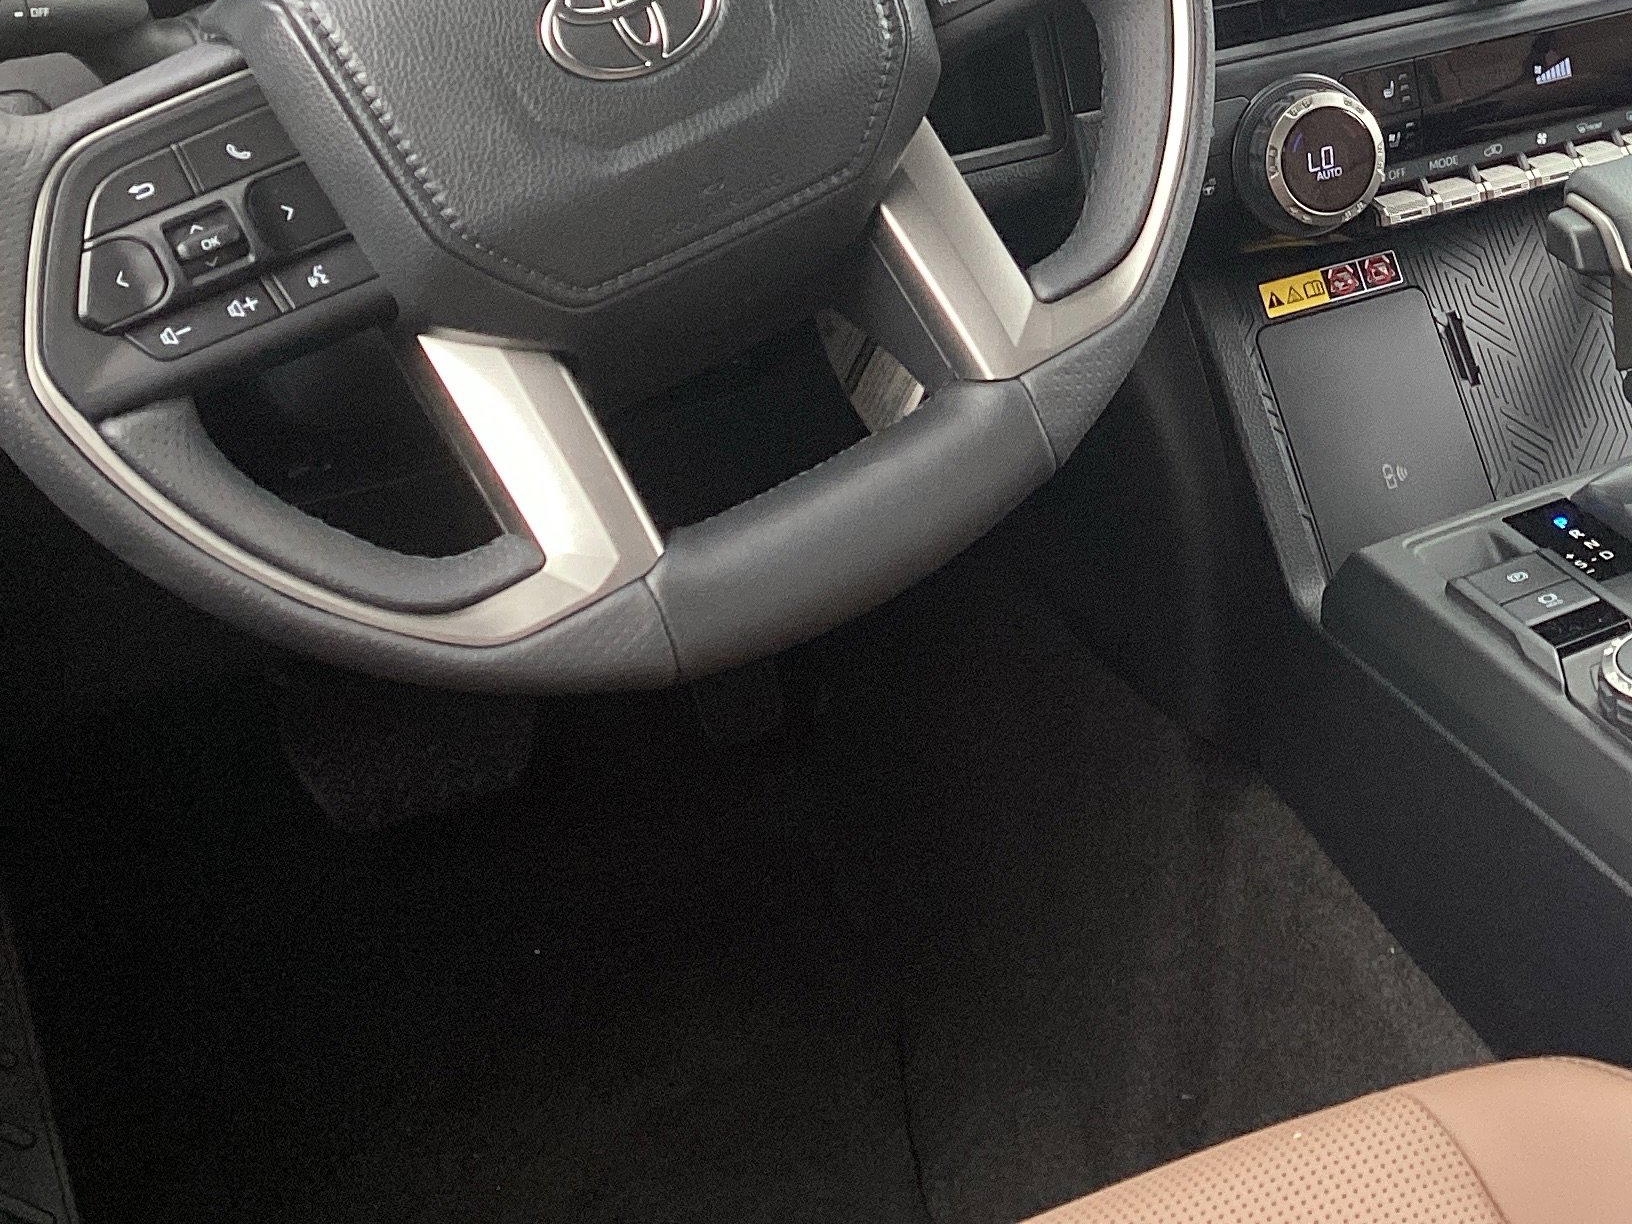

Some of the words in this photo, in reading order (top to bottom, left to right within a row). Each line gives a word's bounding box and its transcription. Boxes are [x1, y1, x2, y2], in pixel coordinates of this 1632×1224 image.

[1307, 145, 1335, 174] LO
[1429, 155, 1459, 171] MODE
[1316, 166, 1343, 182] AUTO
[1388, 167, 1406, 181] OFF
[200, 235, 222, 251] OK
[1583, 539, 1600, 550] N
[1599, 550, 1614, 560] D
